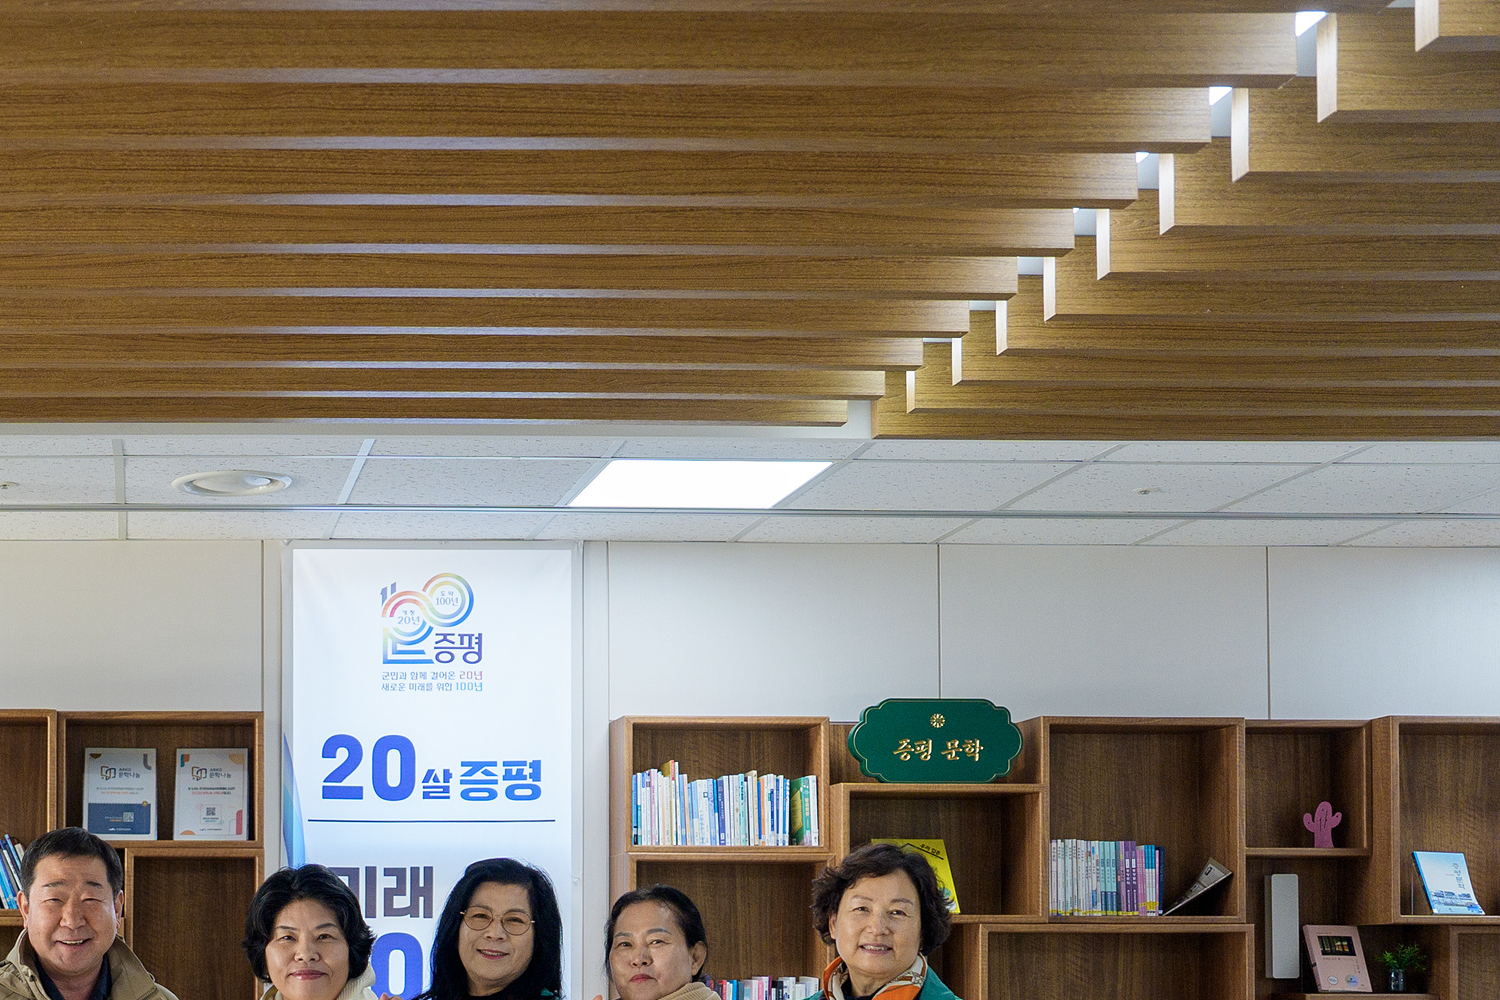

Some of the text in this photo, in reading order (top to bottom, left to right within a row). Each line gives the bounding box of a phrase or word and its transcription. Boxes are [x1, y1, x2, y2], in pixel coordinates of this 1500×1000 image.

[434, 633, 482, 664] 증평
[382, 671, 407, 680] 군민과
[410, 671, 427, 680] 함께
[459, 671, 483, 681] 20년
[381, 682, 406, 692] 새로운
[409, 682, 433, 692] 미래를
[455, 682, 483, 692] 100년
[893, 738, 984, 762] 증평 문학
